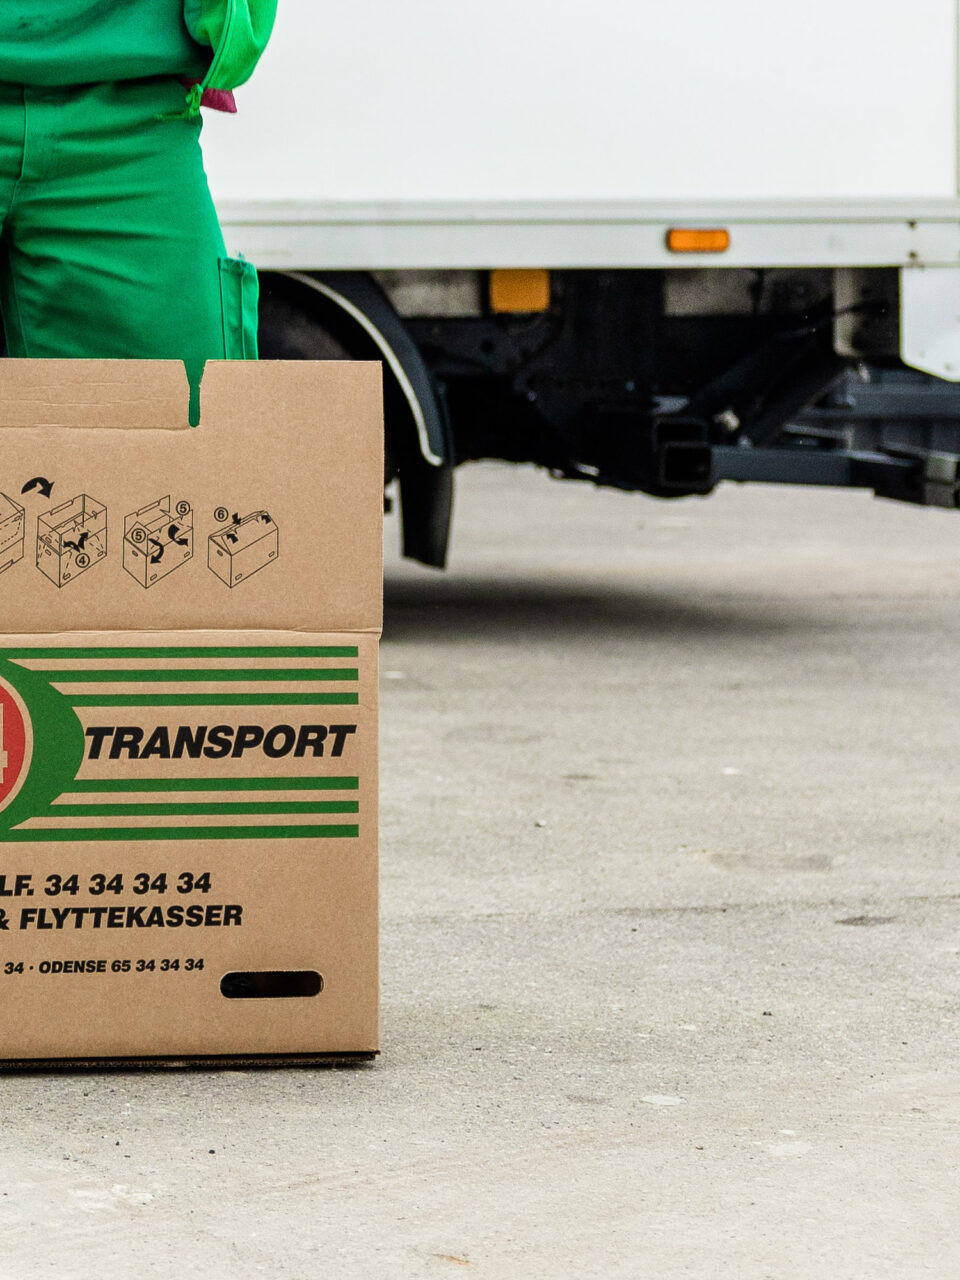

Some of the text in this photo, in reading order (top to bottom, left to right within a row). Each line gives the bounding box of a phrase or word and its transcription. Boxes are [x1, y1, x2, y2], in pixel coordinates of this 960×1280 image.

[85, 724, 357, 760] TRANSPORT
[44, 874, 80, 896] 34
[88, 873, 124, 895] 34
[132, 872, 168, 895] 34
[176, 871, 212, 894] 34
[19, 904, 244, 930] FLYTTEKASSER
[3, 961, 25, 975] 34
[38, 959, 108, 974] ODENSE
[110, 959, 132, 973] 65
[135, 959, 156, 973] 34
[159, 958, 180, 972] 34
[184, 958, 205, 972] 34
